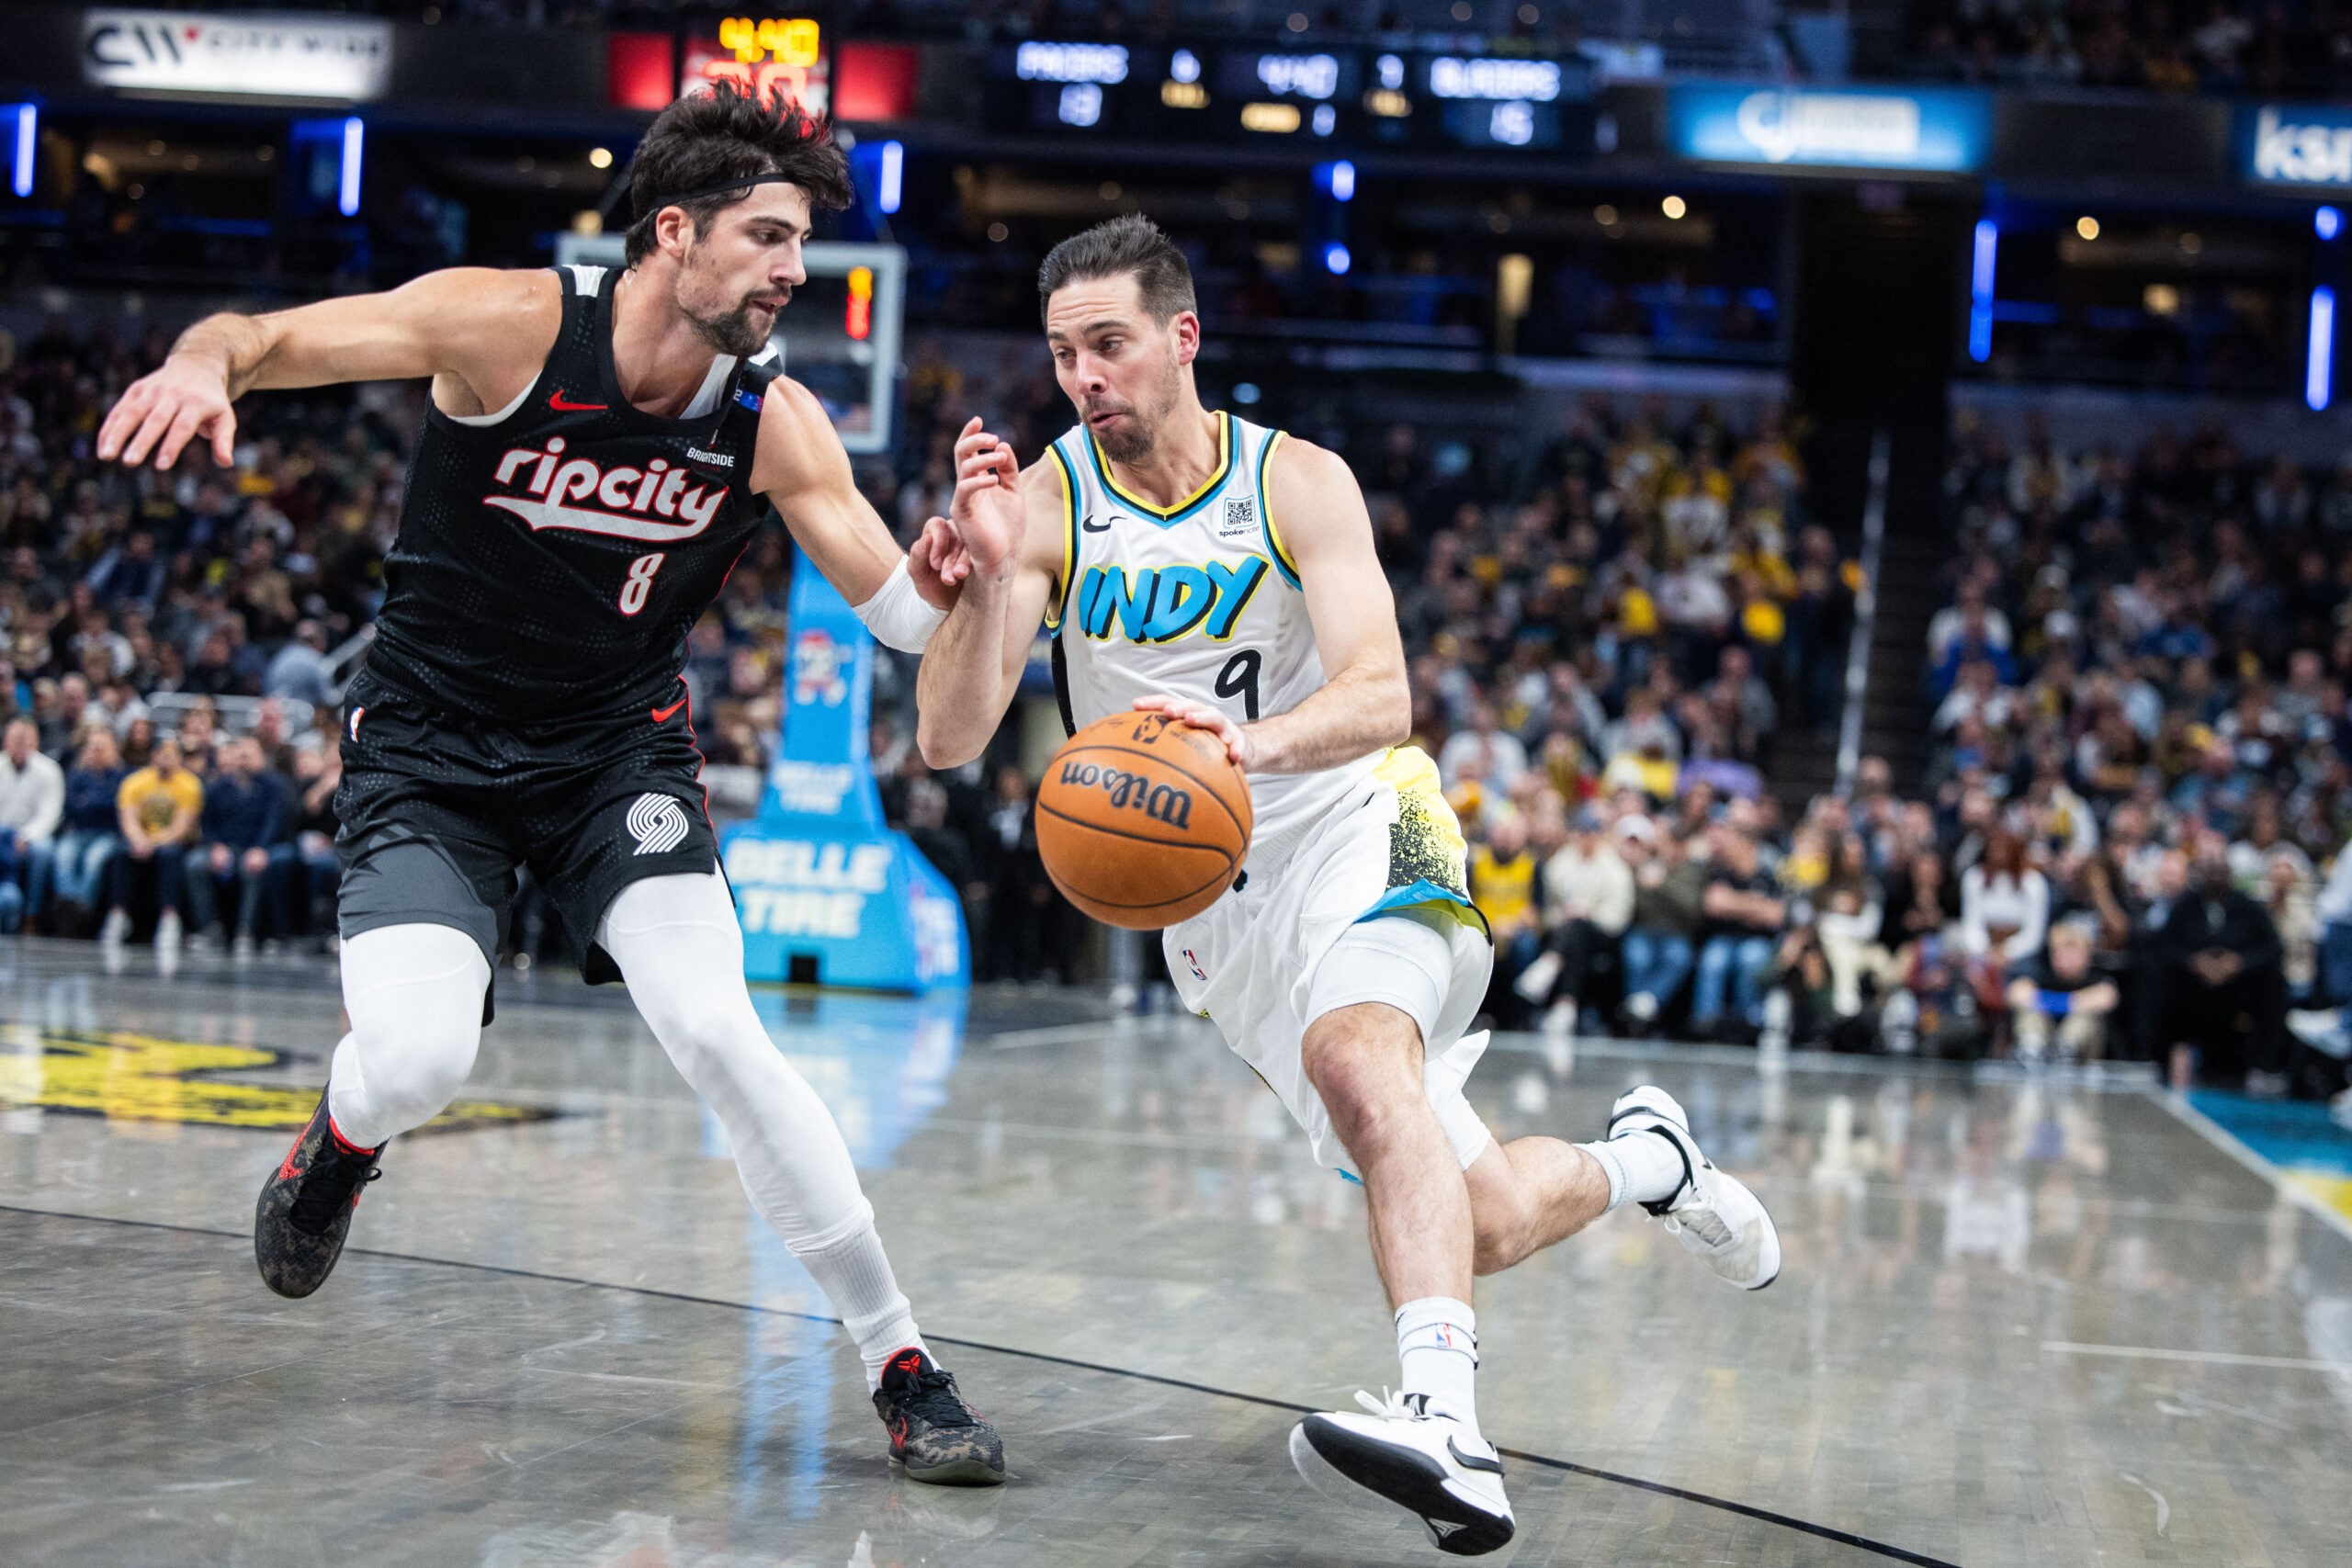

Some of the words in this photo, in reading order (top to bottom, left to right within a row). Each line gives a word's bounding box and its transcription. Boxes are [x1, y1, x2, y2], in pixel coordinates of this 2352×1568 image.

[492, 435, 729, 541] ripcity
[686, 446, 735, 468] BRIGHTSIDE
[618, 552, 666, 616] 8
[1078, 552, 1273, 644] INDY
[1215, 649, 1262, 723] 9
[1059, 761, 1192, 830] Wilson
